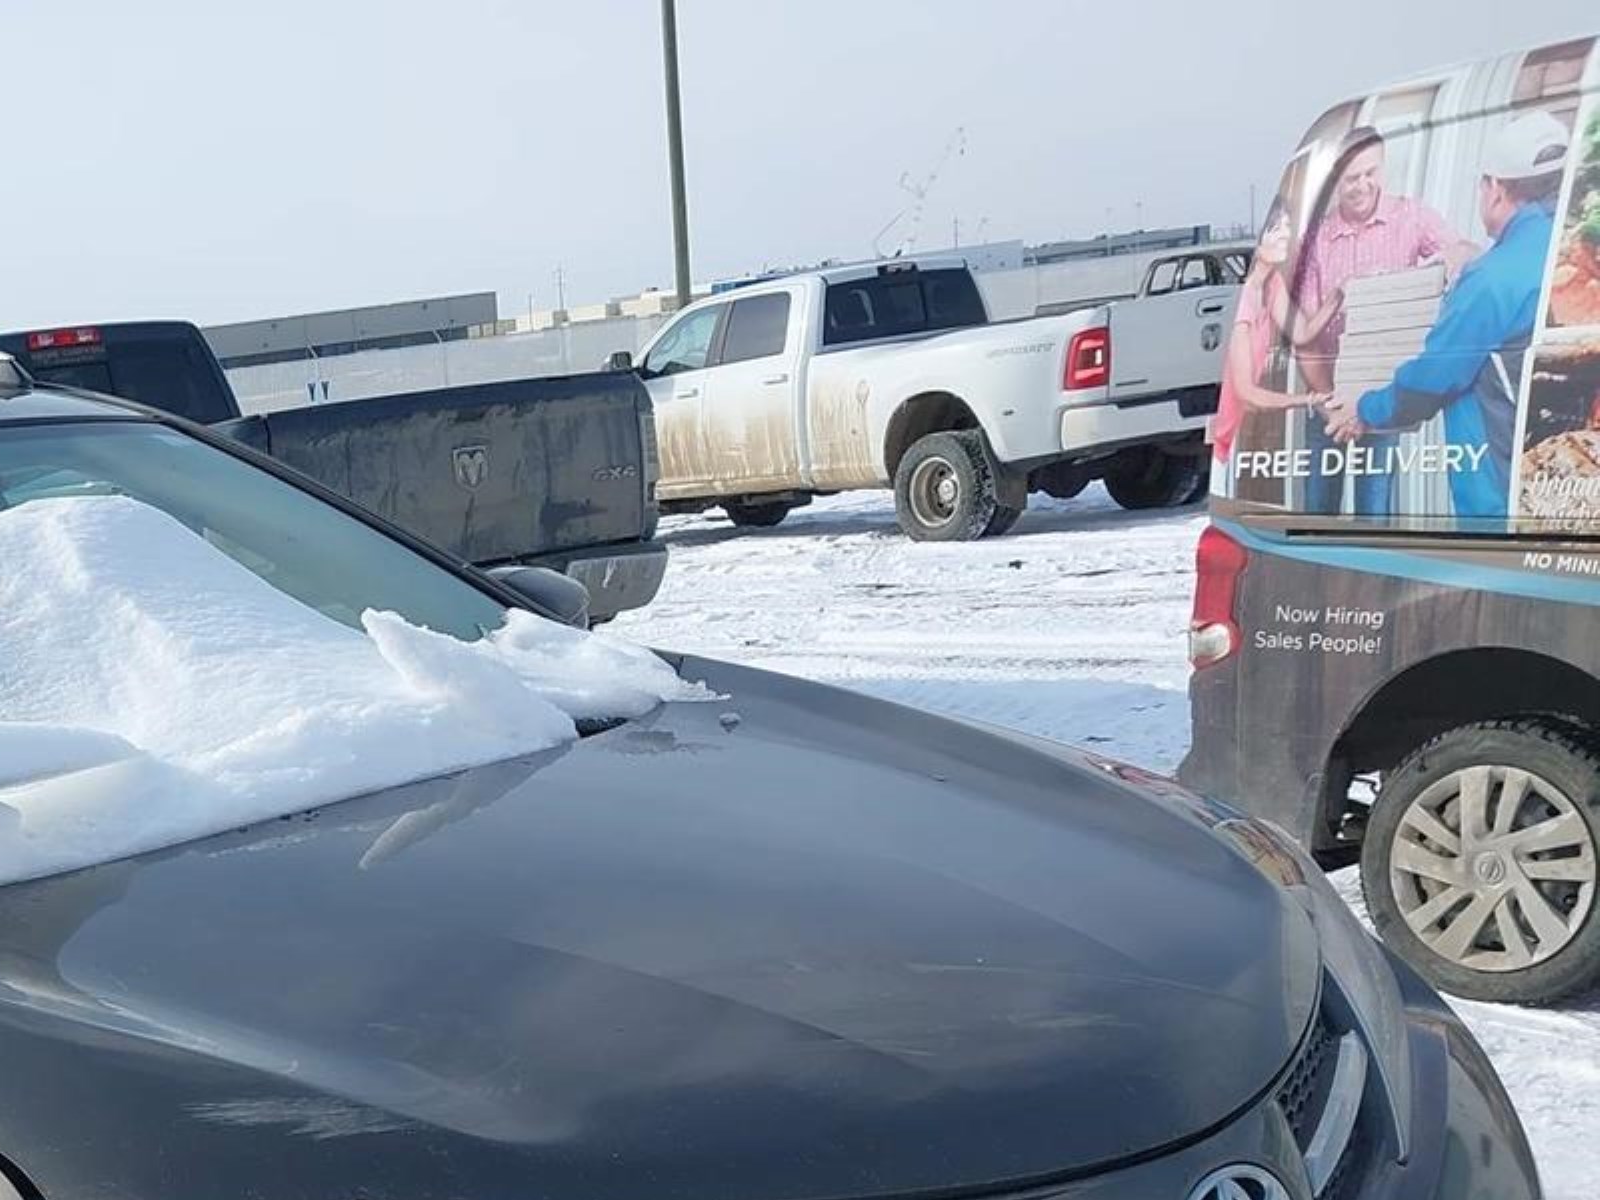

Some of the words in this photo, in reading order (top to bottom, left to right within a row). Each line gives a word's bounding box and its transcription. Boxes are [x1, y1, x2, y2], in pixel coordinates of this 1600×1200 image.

[1234, 449, 1312, 479] FREE
[1320, 443, 1489, 477] DELIVERY
[1523, 552, 1553, 570] NO
[1557, 554, 1600, 575] MINI
[1275, 605, 1320, 623] Now
[1325, 607, 1385, 630] Hiring
[1254, 630, 1303, 650] Sales
[1309, 633, 1382, 656] People!
